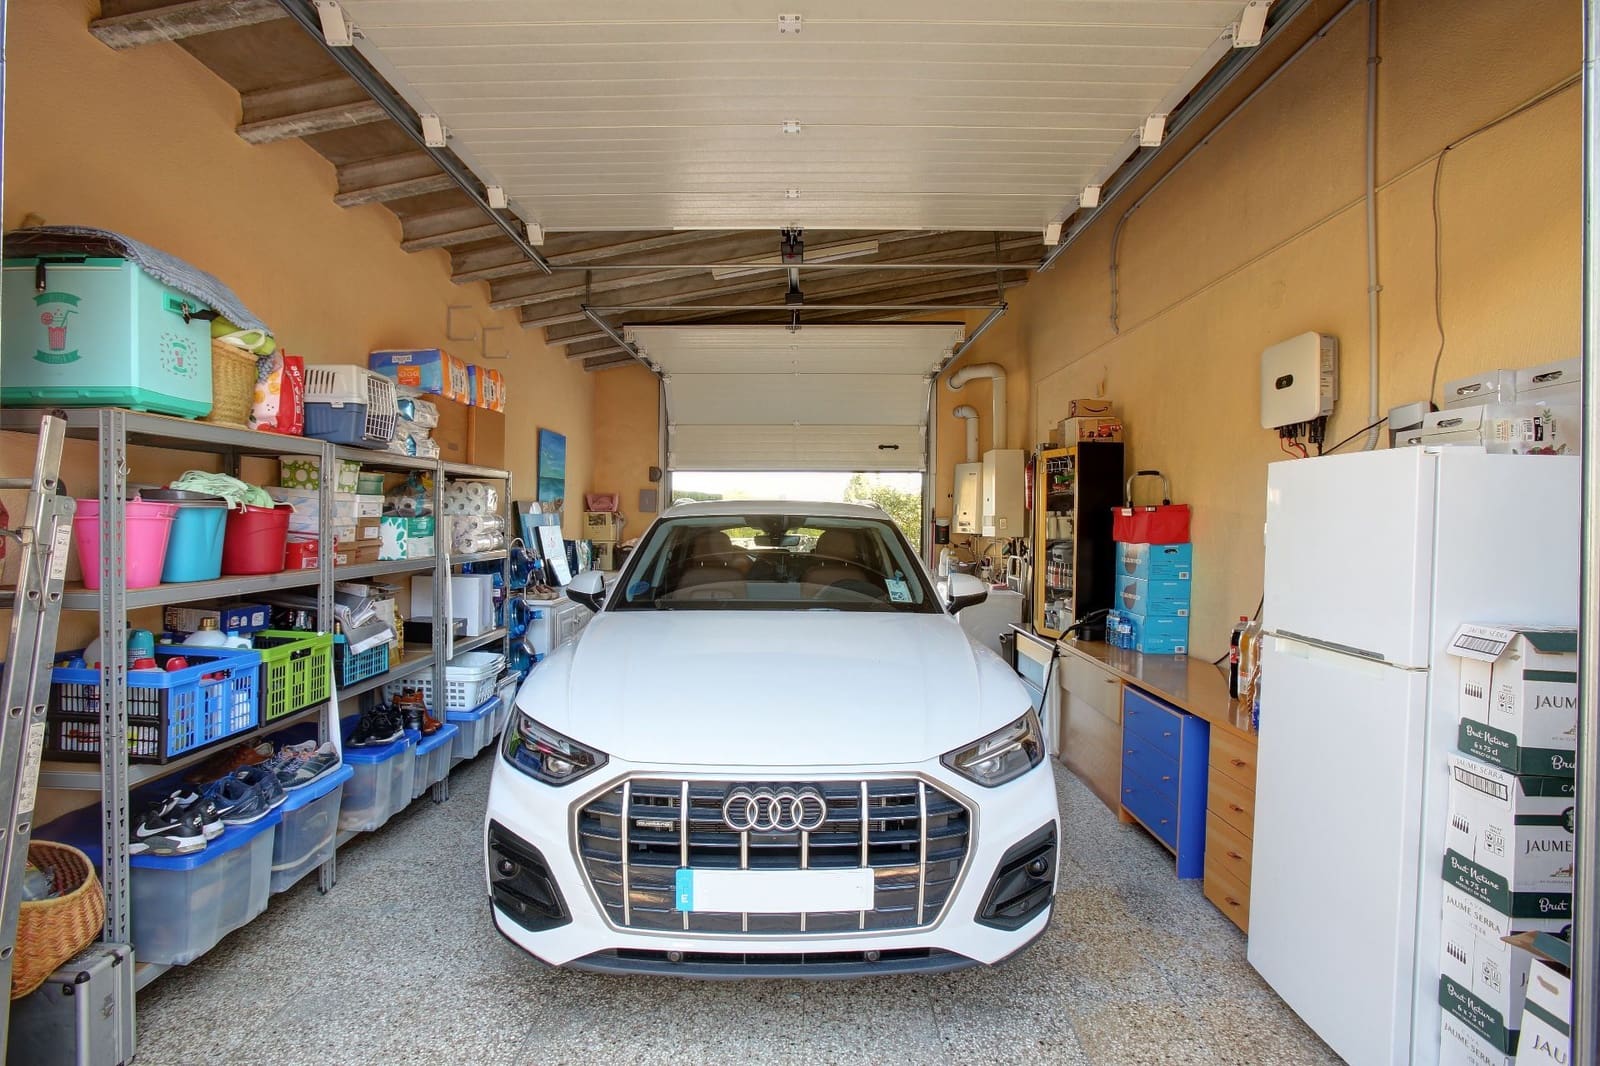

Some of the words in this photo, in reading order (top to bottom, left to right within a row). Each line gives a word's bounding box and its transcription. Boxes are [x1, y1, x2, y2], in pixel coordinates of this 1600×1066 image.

[1466, 725, 1484, 739] Brut
[1484, 731, 1509, 748] Nature
[1483, 745, 1491, 753] 75
[1480, 767, 1504, 781] SERRA
[1525, 839, 1573, 855] JAUME
[1451, 856, 1469, 874] Brut
[1470, 867, 1500, 890] Nature
[1470, 880, 1479, 891] 75
[1539, 897, 1568, 912] Brut
[1446, 895, 1472, 915] JAUME
[1474, 911, 1501, 933] SERRA
[1447, 982, 1467, 1003] Brut
